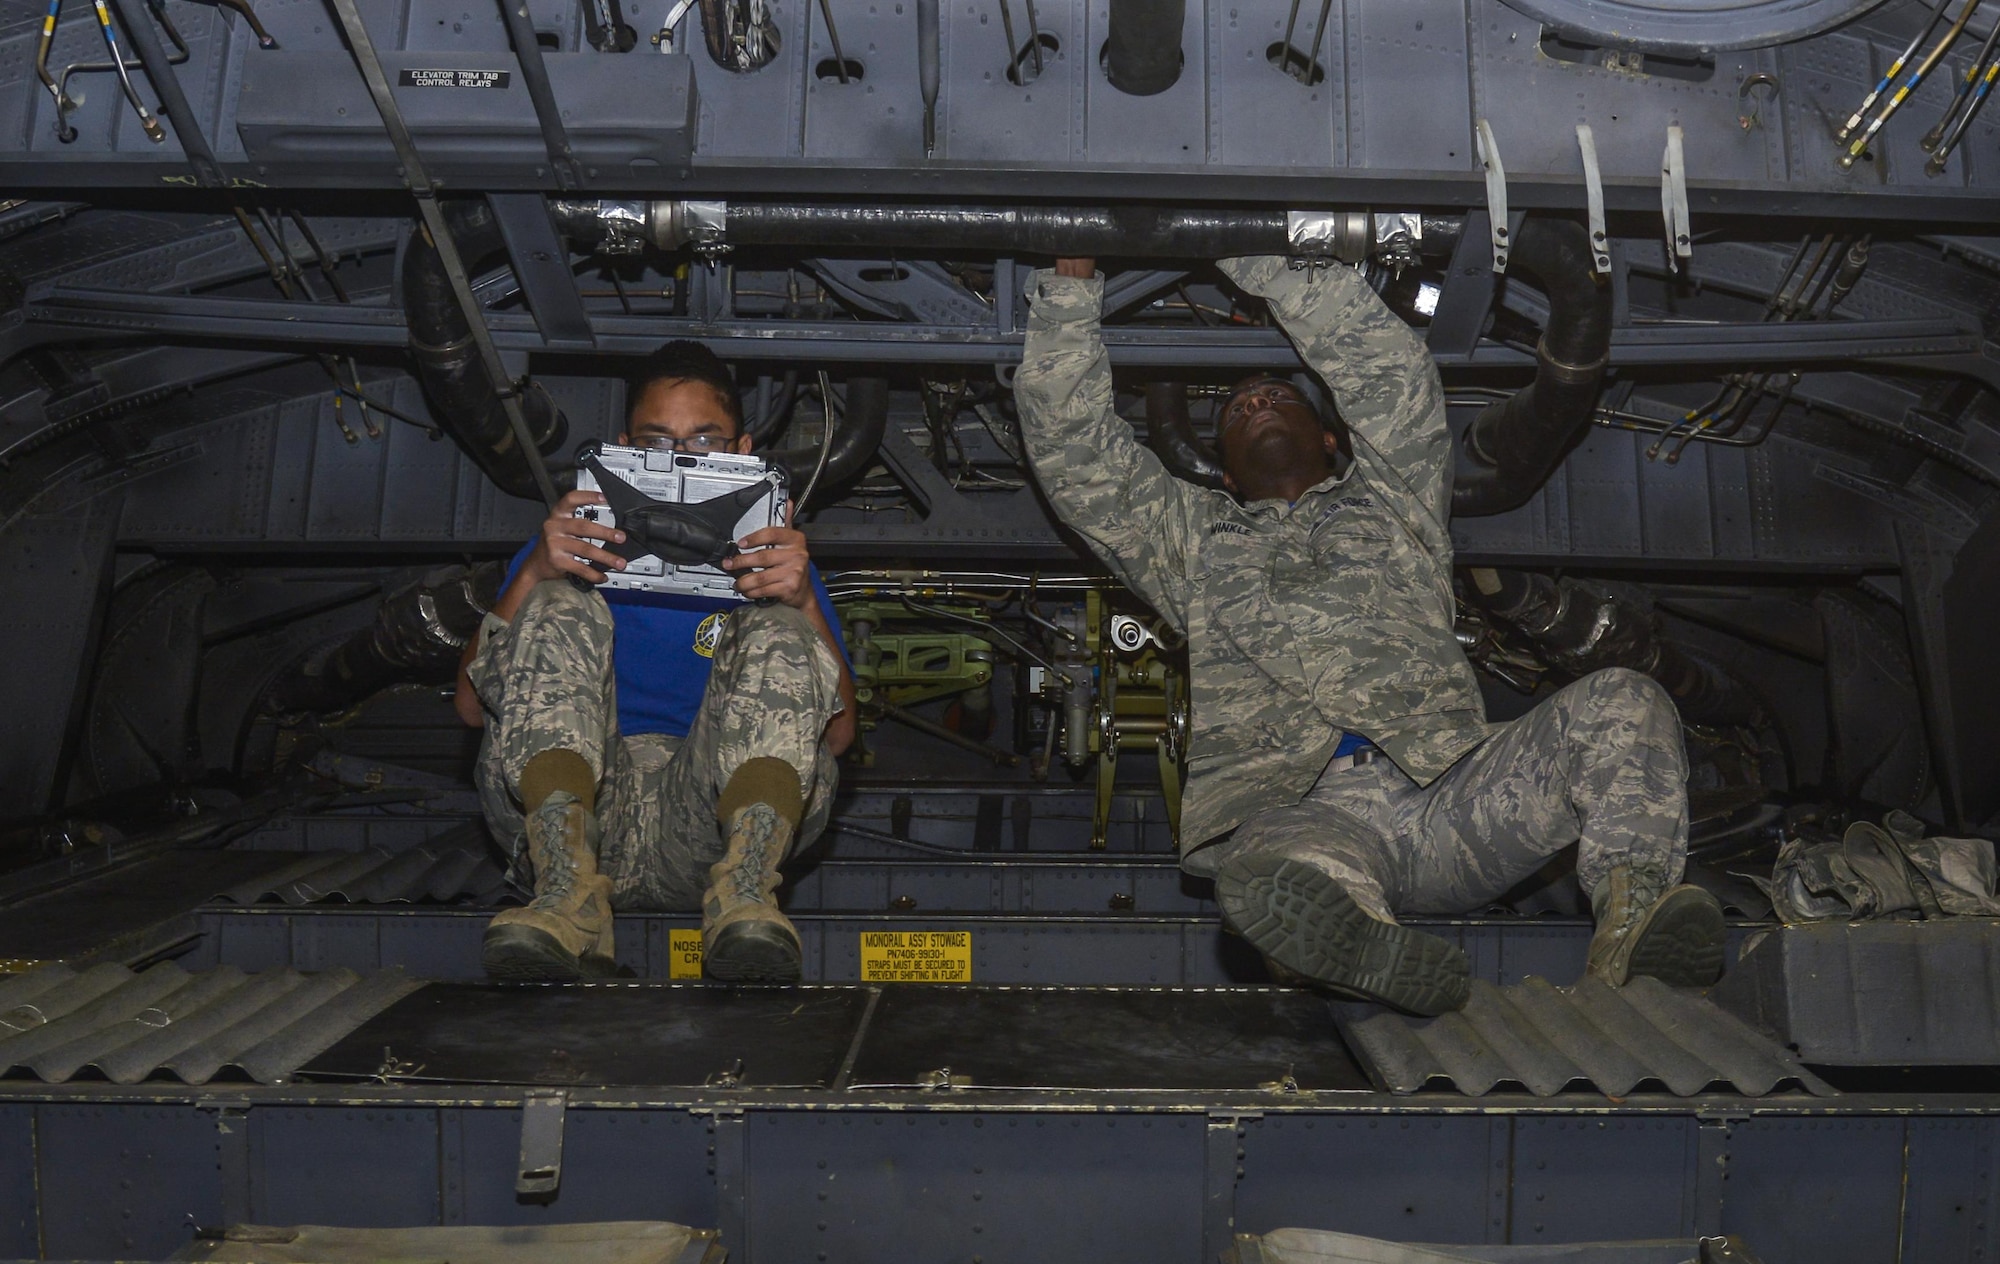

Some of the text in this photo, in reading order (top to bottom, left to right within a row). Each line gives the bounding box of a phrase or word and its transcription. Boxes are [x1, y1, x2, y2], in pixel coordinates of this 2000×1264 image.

[411, 71, 498, 80] ELEVATOR TRIM TAB
[459, 79, 492, 88] RELAYS
[1340, 496, 1374, 508] FORCE
[865, 933, 966, 948] MONORAIL ASSY STOWAGE
[673, 941, 703, 952] NOSE
[684, 953, 703, 964] CR
[867, 960, 966, 970] STRAPS MUST BE SECURED TO
[868, 970, 964, 980] PREVENT SHIFTING IN FLIGHT
